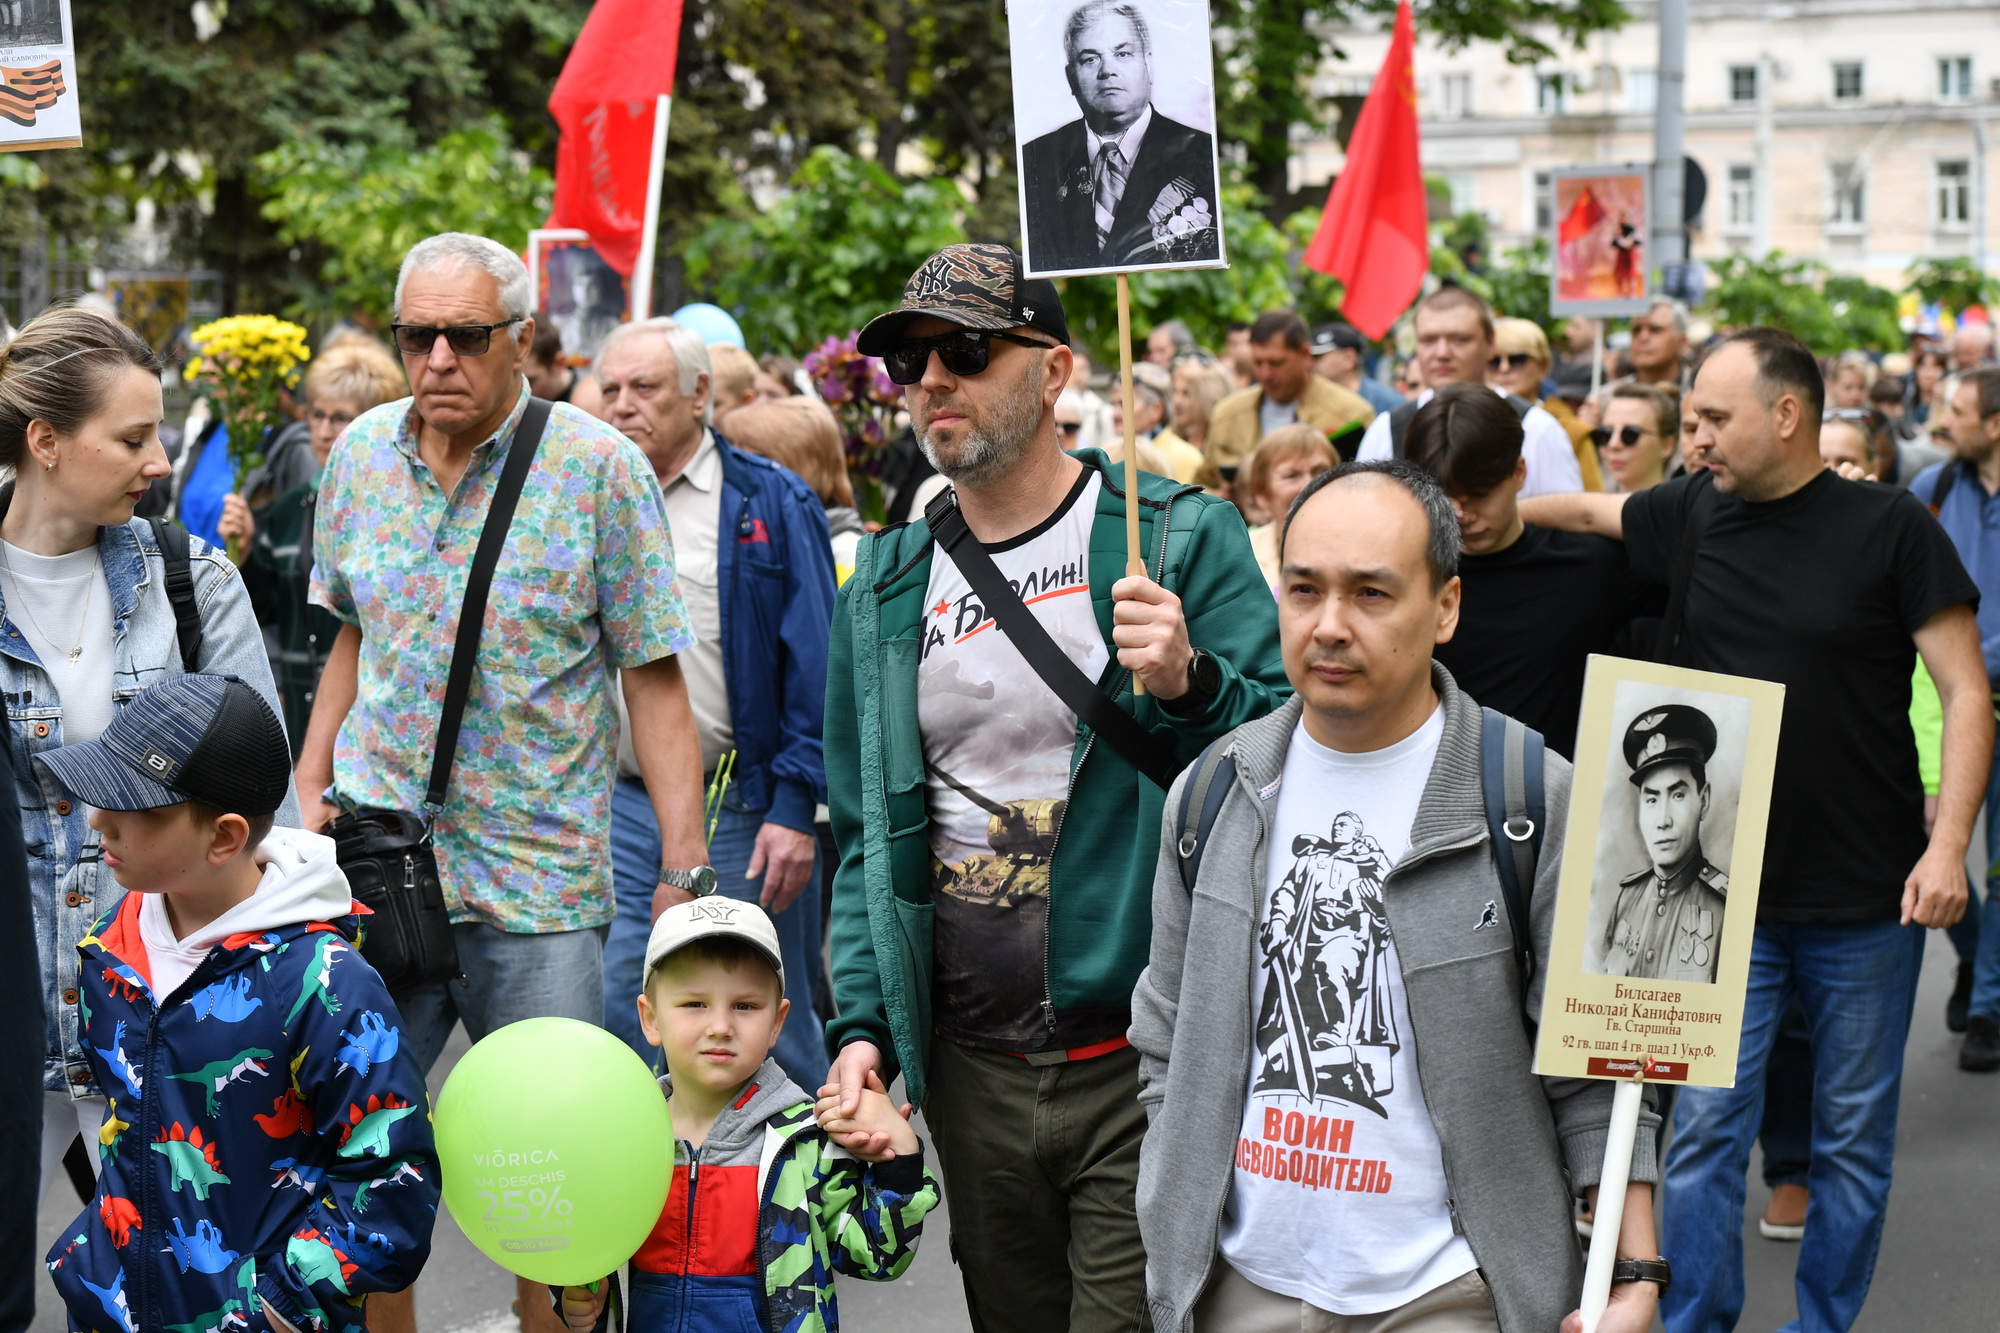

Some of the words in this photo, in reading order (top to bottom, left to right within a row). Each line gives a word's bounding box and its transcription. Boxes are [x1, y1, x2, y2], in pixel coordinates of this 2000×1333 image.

[916, 256, 954, 298] NY
[689, 902, 740, 925] NY
[1615, 983, 1682, 1003] Билсагаев
[1564, 997, 1628, 1018] Николай
[1631, 1003, 1722, 1025] Канифатович
[1606, 1018, 1622, 1031] Гв.
[1625, 1020, 1682, 1037] Старшина
[1562, 1035, 1574, 1048] 92
[1577, 1040, 1592, 1049] гв.
[1594, 1041, 1619, 1052] шап
[1621, 1040, 1628, 1052] 4
[1630, 1043, 1644, 1053] гв.
[1647, 1044, 1670, 1056] шад
[1672, 1043, 1677, 1055] 1
[1679, 1043, 1717, 1060] Укр.Ф.
[1263, 1106, 1355, 1154] ВОИН
[474, 1177, 495, 1188] AM
[498, 1170, 566, 1188] DESCHIS
[475, 1184, 573, 1222] 25%
[485, 1218, 576, 1234] REDUCERE
